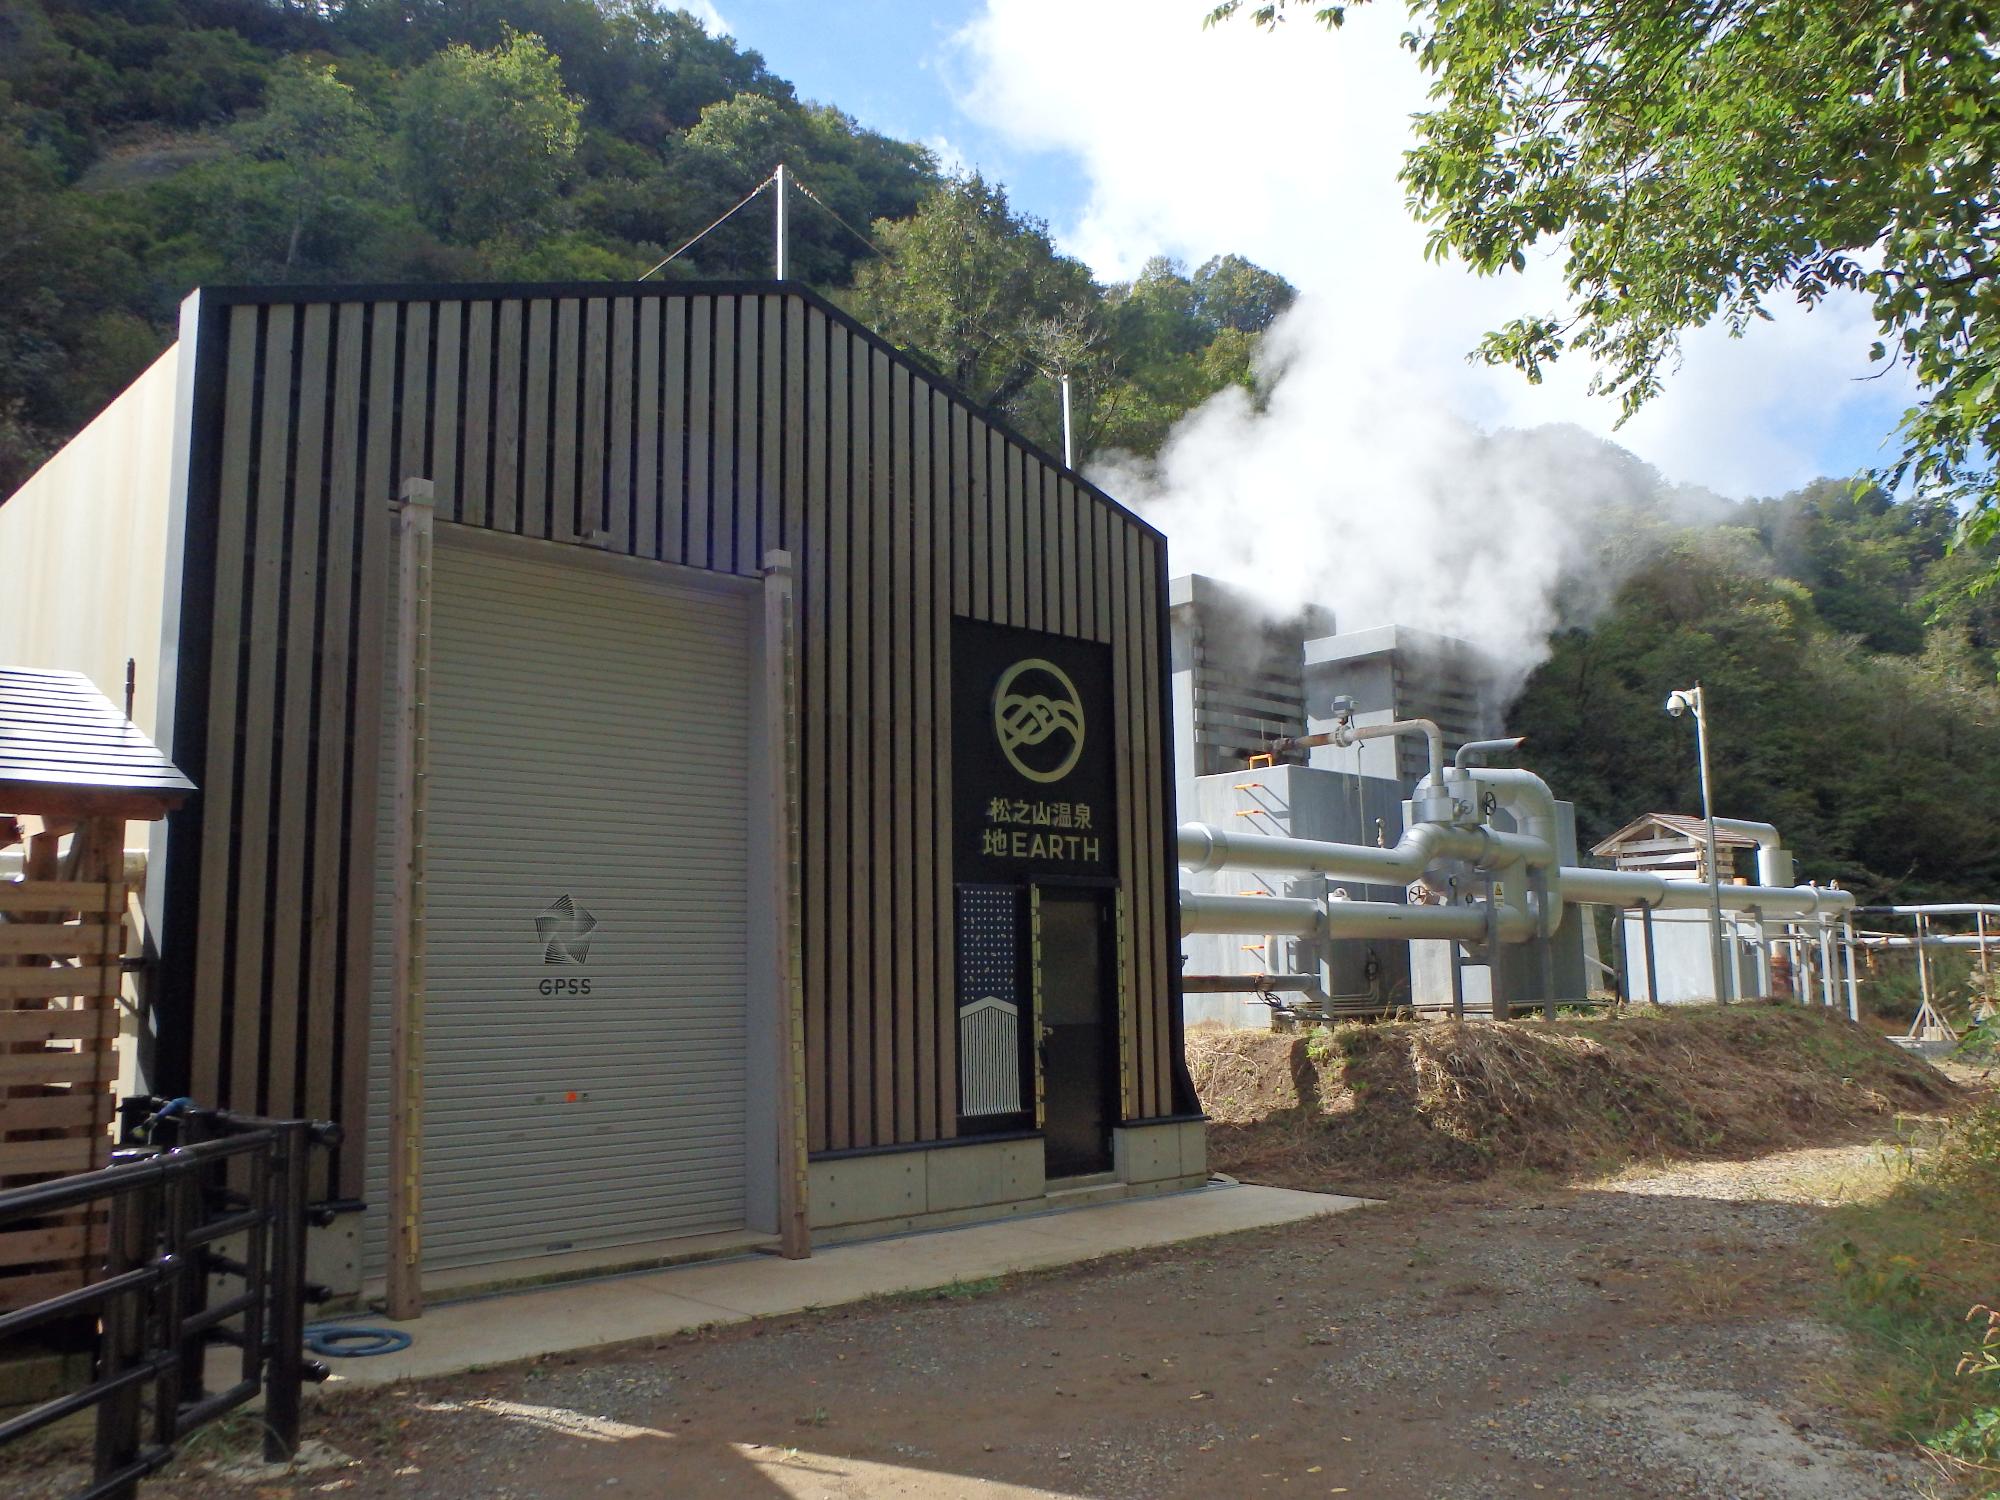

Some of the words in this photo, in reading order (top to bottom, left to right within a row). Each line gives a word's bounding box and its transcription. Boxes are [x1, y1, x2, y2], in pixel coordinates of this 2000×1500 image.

[987, 797, 1092, 829] 松之山温泉
[983, 829, 1099, 861] 地EARTH
[539, 979, 591, 995] GPSS
